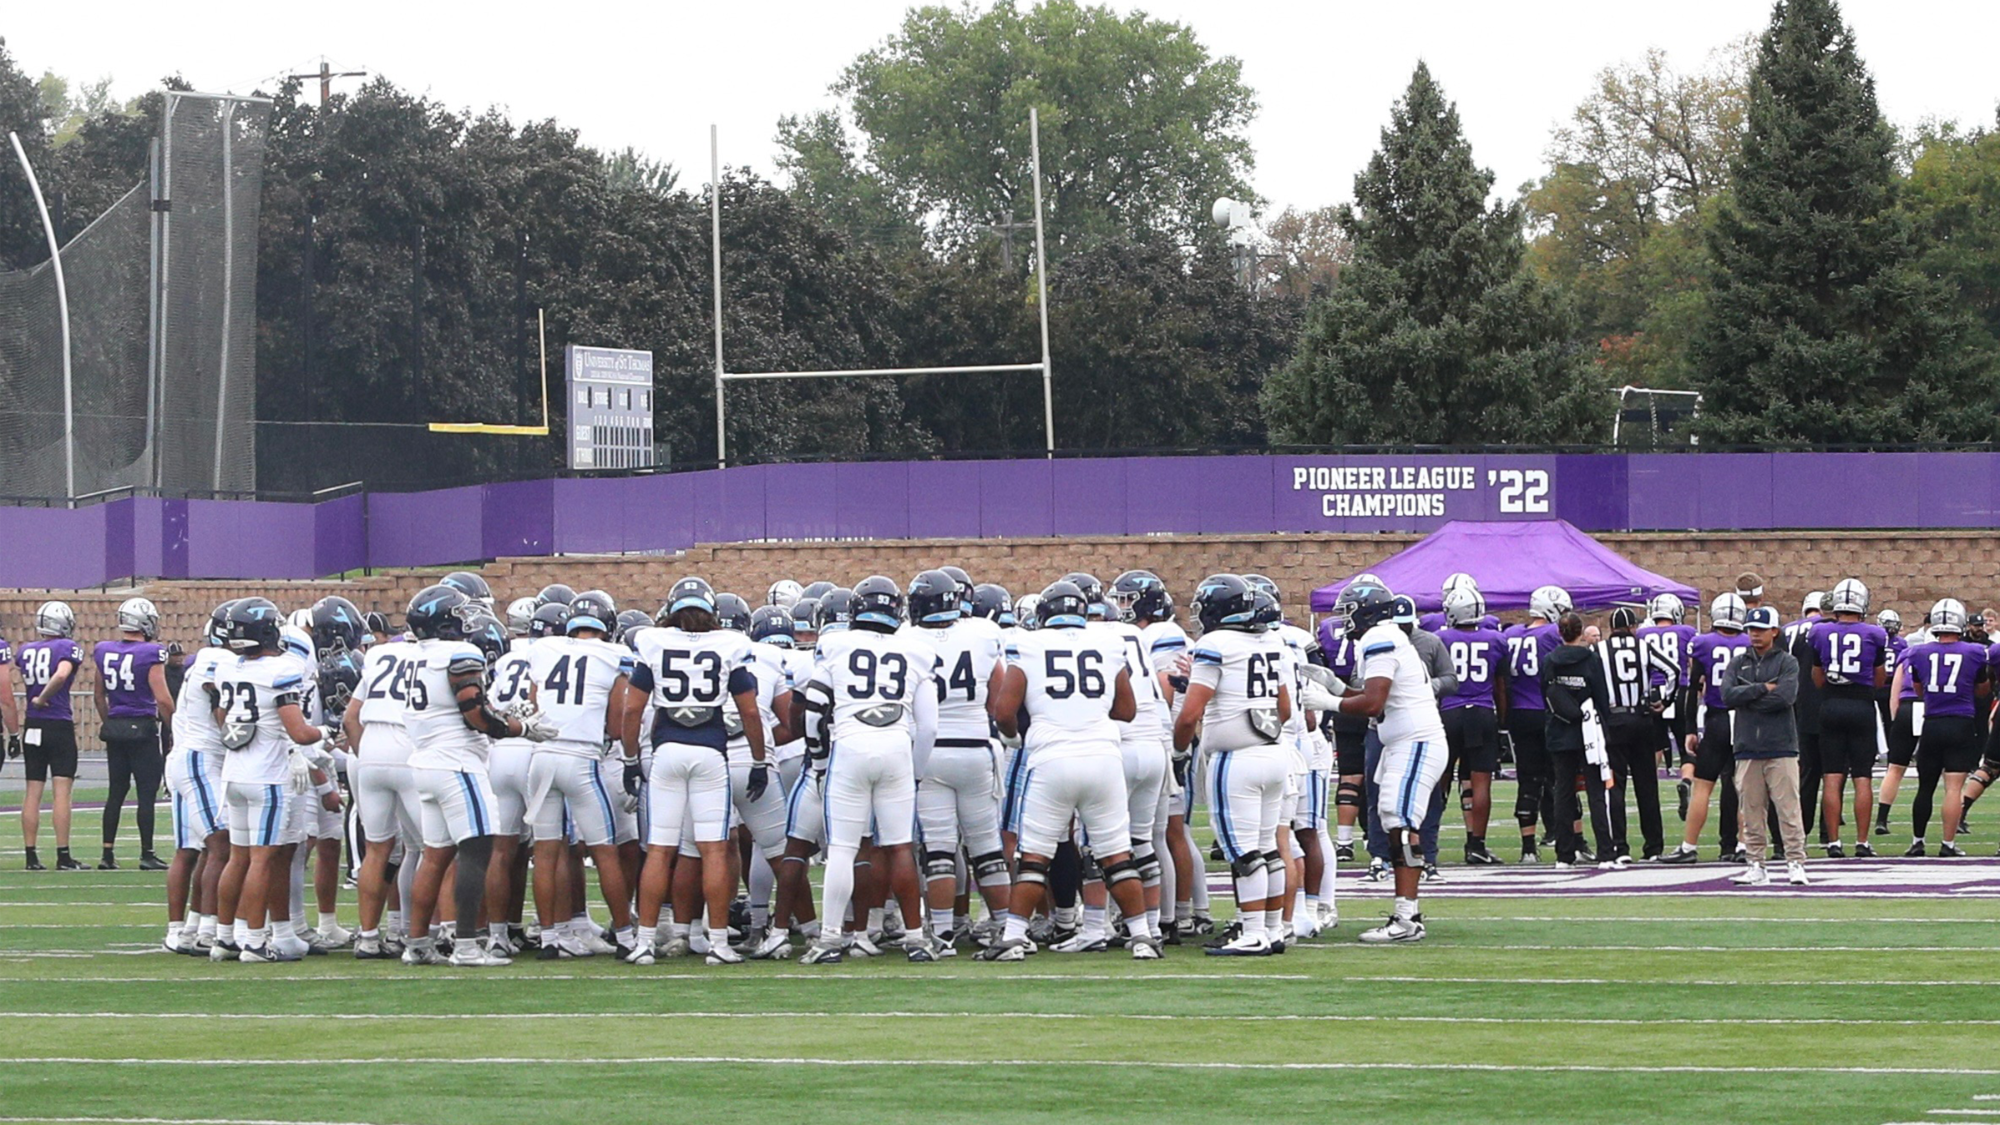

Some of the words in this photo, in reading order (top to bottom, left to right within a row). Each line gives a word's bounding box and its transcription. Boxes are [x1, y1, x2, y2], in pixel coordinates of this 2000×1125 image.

[1293, 467, 1385, 490] PIONEER
[1390, 467, 1475, 490] LEAGUE
[1487, 469, 1549, 513] '22
[1322, 493, 1445, 517] CHAMPIONS
[577, 600, 589, 610] 41
[877, 594, 890, 605] 93
[1064, 597, 1077, 606] 56
[532, 620, 544, 631] 35
[720, 618, 733, 628] 75
[22, 647, 51, 685] 38
[71, 646, 84, 661] 38
[103, 652, 135, 691] 54
[1449, 641, 1489, 682] 85
[1507, 636, 1539, 677] 73
[1614, 649, 1638, 681] C
[1828, 632, 1862, 673] 12
[545, 655, 588, 705] 41
[662, 649, 721, 702] 53
[847, 648, 908, 700] 93
[1045, 649, 1105, 699] 56
[1247, 652, 1280, 699] 65
[1927, 653, 1962, 693] 17
